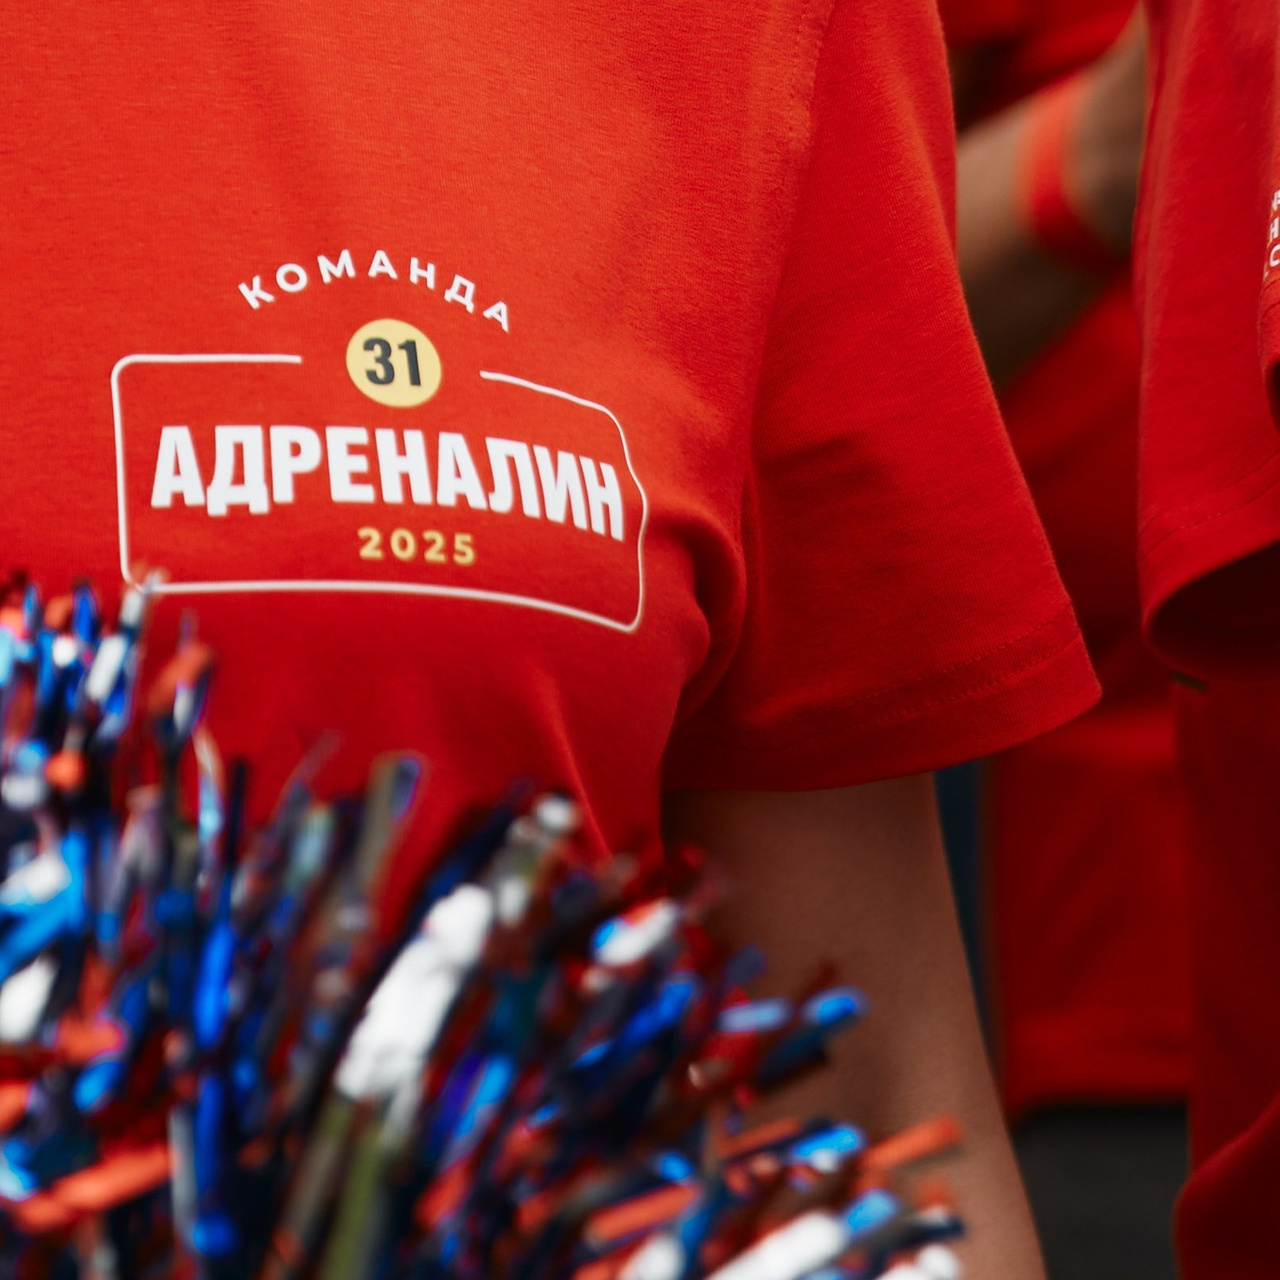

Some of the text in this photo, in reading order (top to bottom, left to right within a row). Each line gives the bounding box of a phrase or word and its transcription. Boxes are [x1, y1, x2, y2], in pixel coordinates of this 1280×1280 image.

[238, 249, 510, 333] КОМАНДА
[363, 337, 422, 387] 31
[151, 425, 623, 542] АДРЕНАЛИН
[358, 527, 476, 565] 2025
